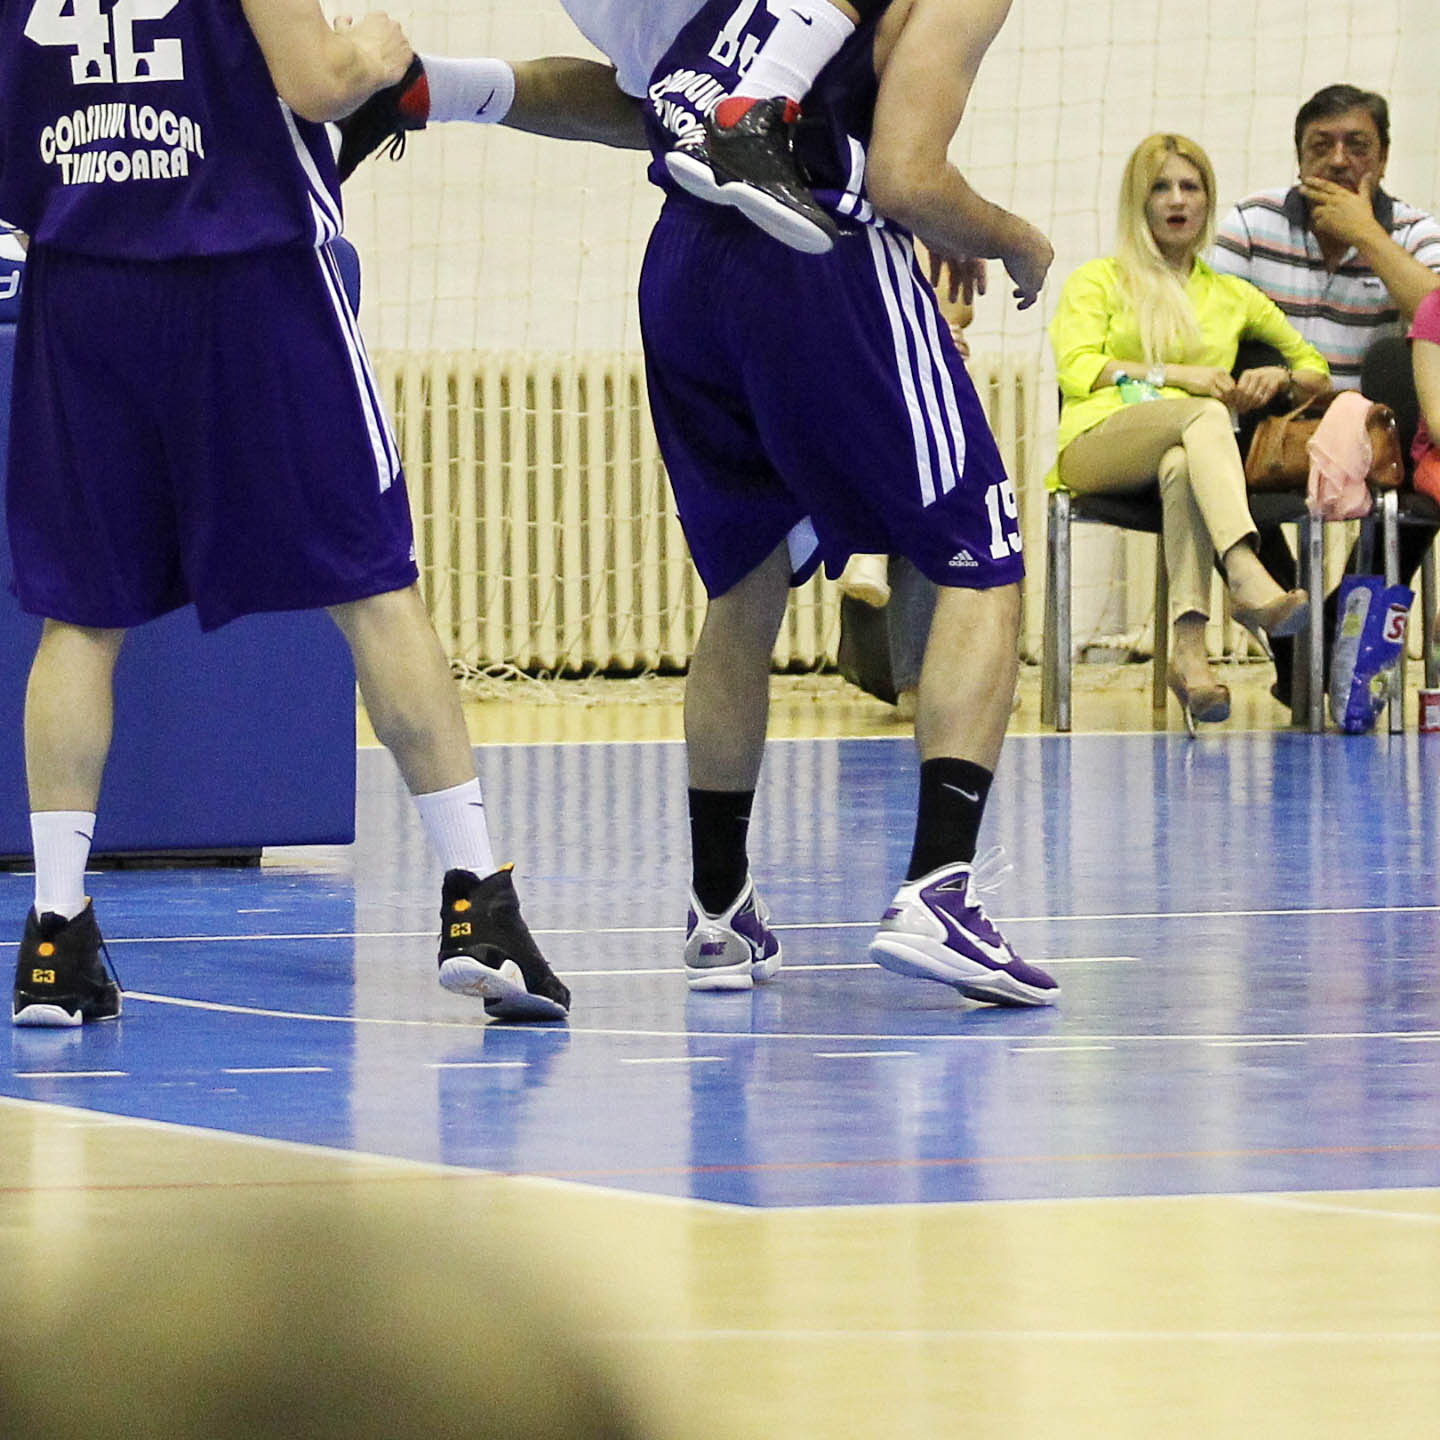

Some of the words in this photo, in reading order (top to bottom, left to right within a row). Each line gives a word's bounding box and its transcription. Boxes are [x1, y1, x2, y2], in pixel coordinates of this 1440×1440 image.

[128, 103, 206, 160] LOCAL
[450, 922, 472, 938] 23
[32, 969, 56, 984] 23
